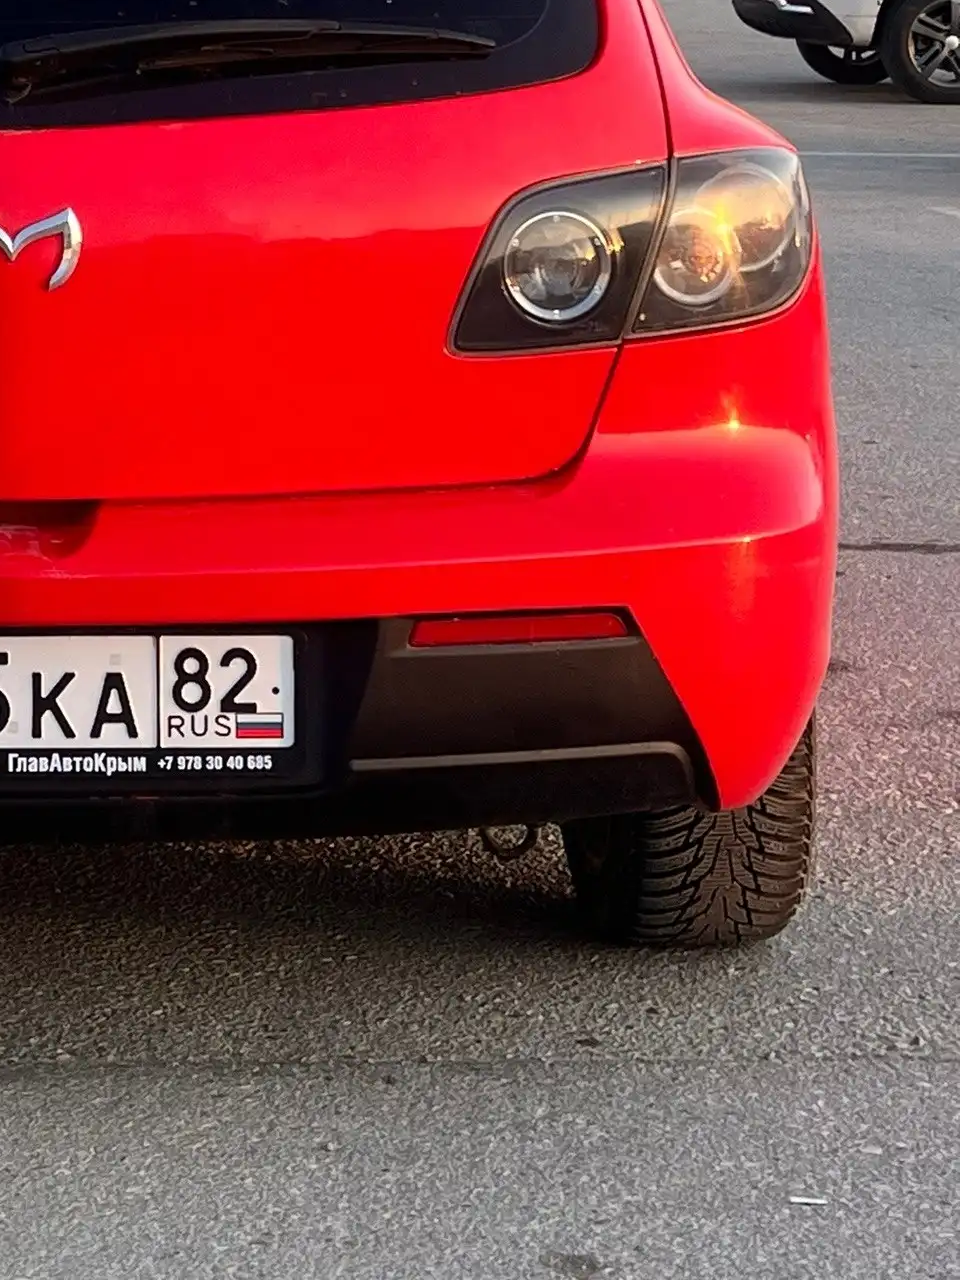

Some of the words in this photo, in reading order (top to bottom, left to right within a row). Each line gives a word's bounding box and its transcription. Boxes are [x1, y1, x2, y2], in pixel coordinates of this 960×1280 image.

[172, 647, 257, 716] 82
[167, 715, 232, 738] RUS
[8, 752, 147, 776] ГлавАвтоКрым
[157, 755, 173, 771] +7
[177, 755, 203, 770] 978
[205, 755, 223, 770] 30
[226, 755, 244, 770] 40
[246, 754, 273, 770] 685
